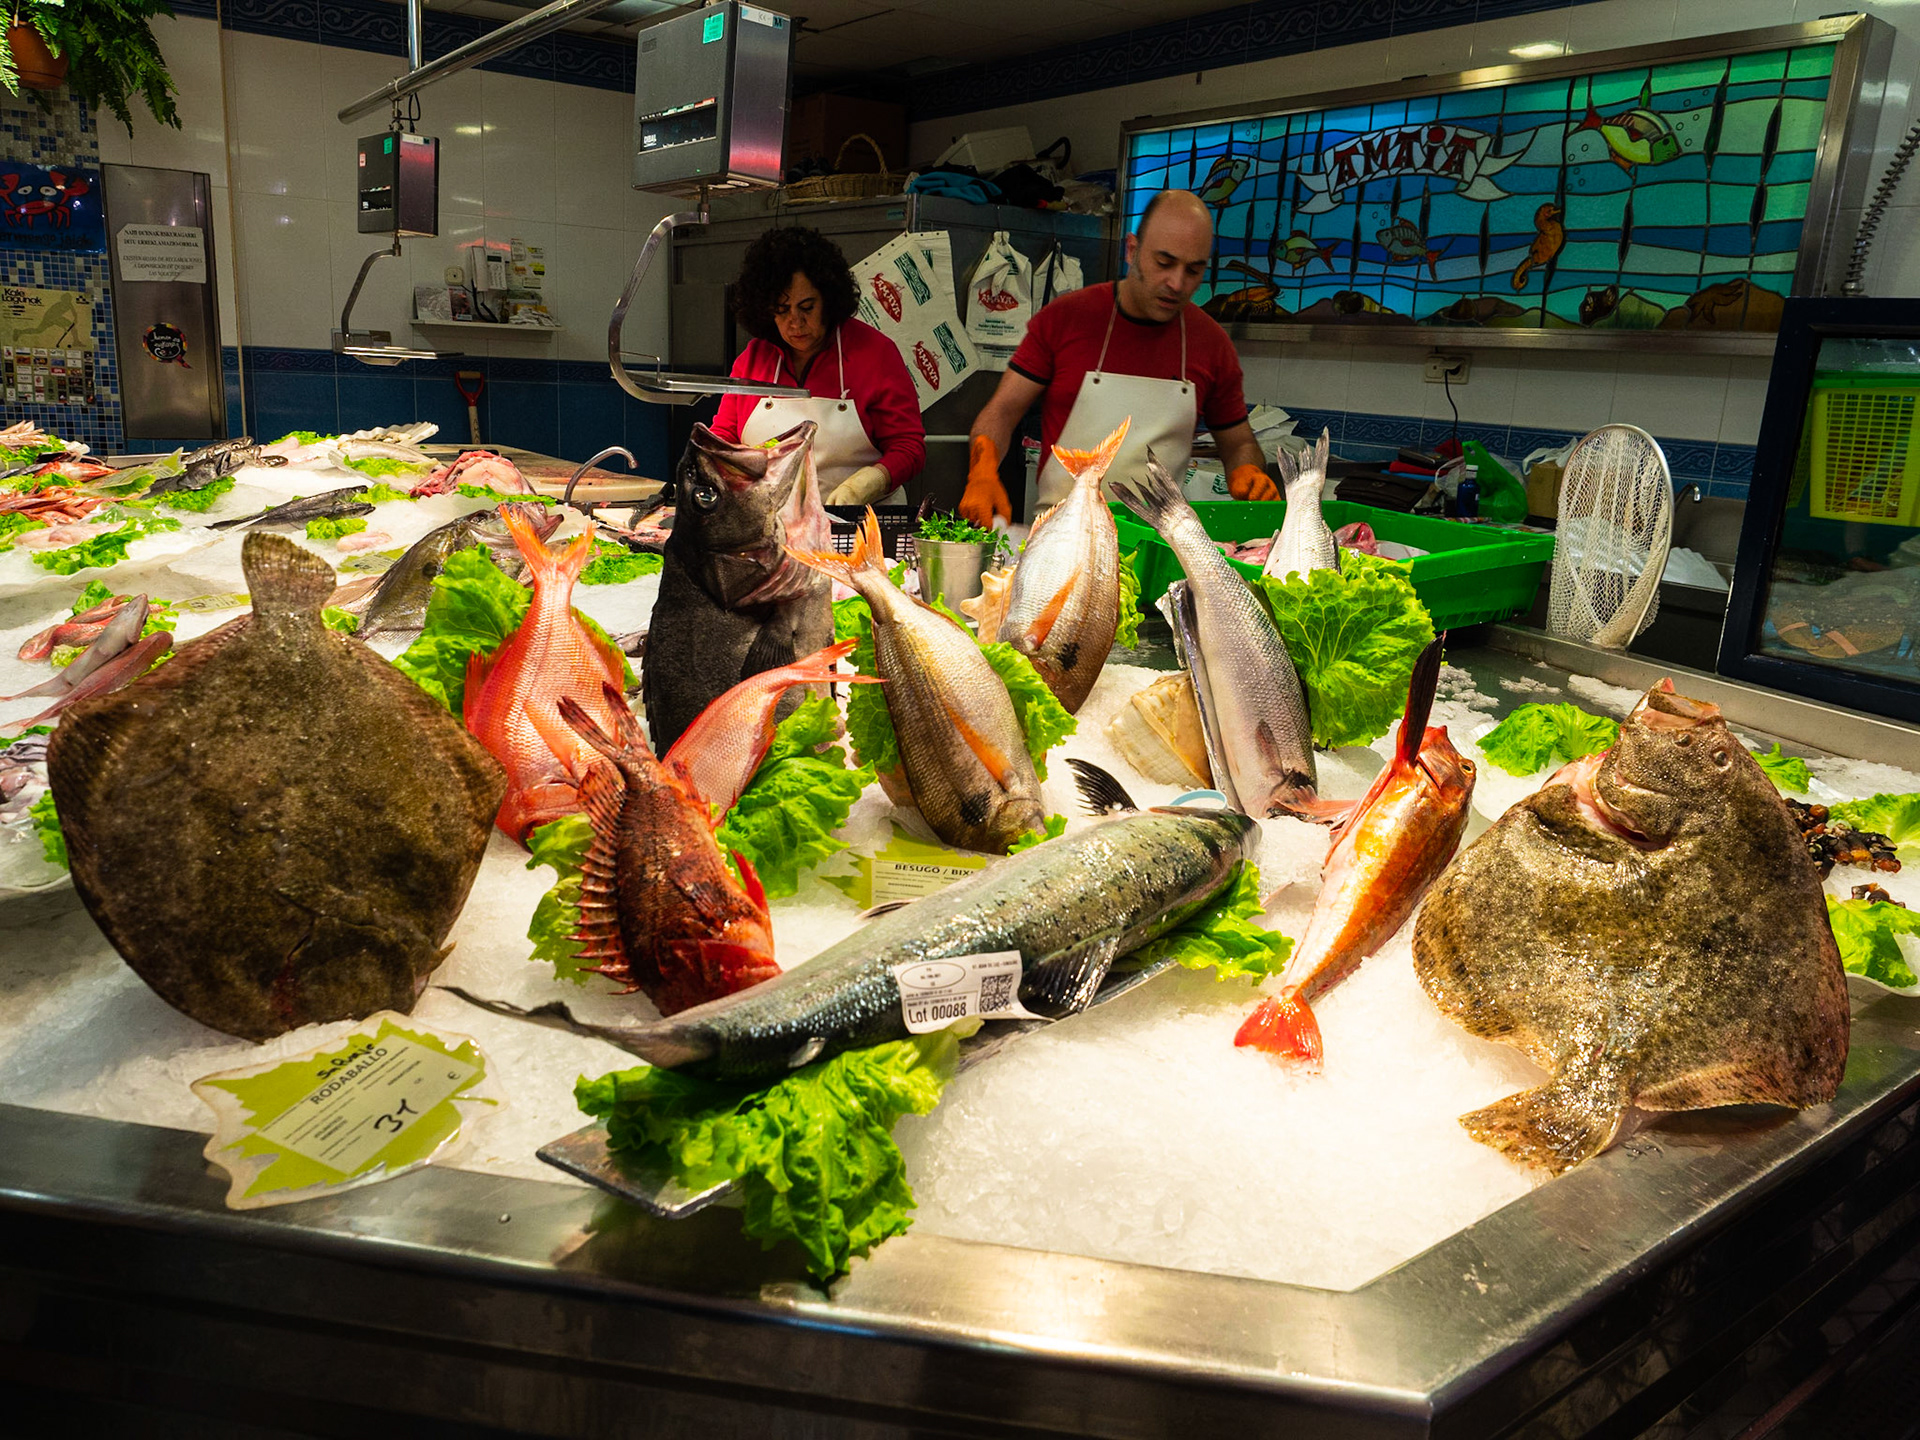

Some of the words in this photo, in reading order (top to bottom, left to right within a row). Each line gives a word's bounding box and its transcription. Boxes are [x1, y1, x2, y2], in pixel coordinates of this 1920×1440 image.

[1, 293, 43, 305] Lagunak
[4, 288, 26, 297] Kale
[876, 279, 901, 318] AMAYA
[916, 346, 939, 386] AMAYA
[894, 863, 941, 874] BESUGO
[951, 868, 975, 876] BIX
[908, 1008, 928, 1024] Lot
[931, 1002, 967, 1021] 00088
[310, 1047, 388, 1105] RODABALLO
